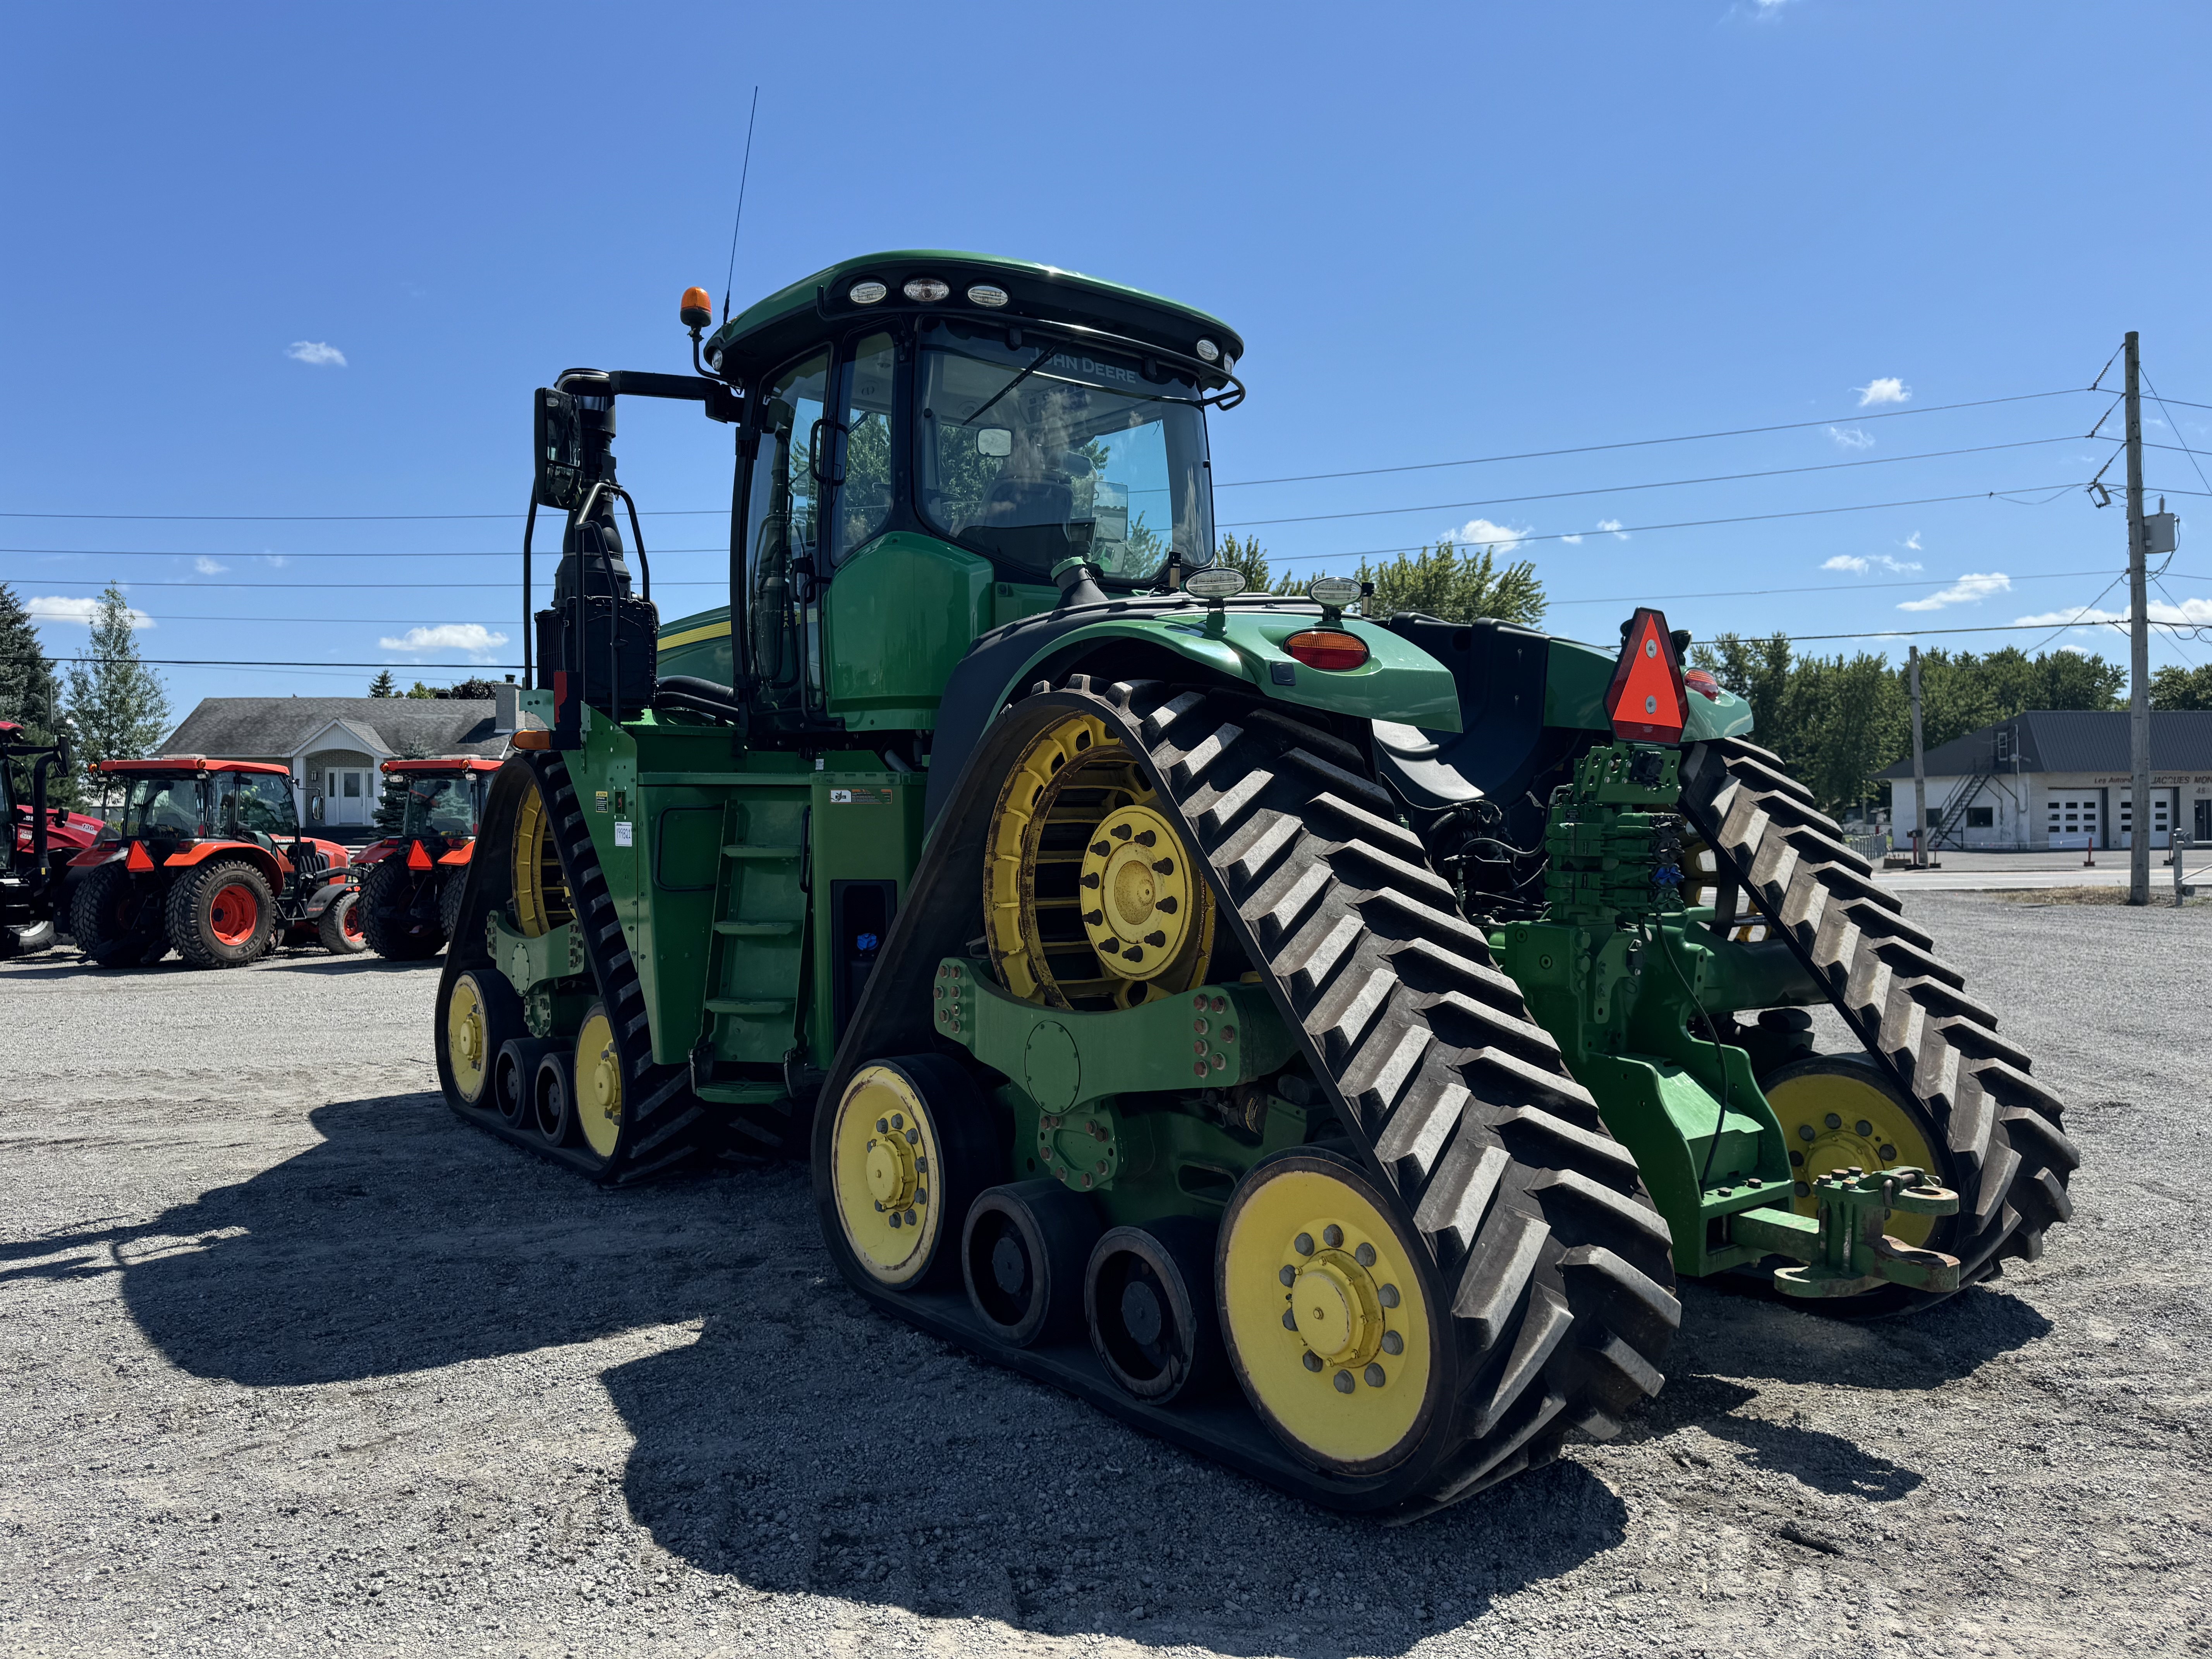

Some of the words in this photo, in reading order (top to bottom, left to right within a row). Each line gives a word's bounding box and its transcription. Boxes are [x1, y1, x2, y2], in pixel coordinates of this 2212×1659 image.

[1082, 357, 1136, 384] DEERE
[2150, 776, 2190, 784] JACQUES
[617, 828, 631, 839] 199821
